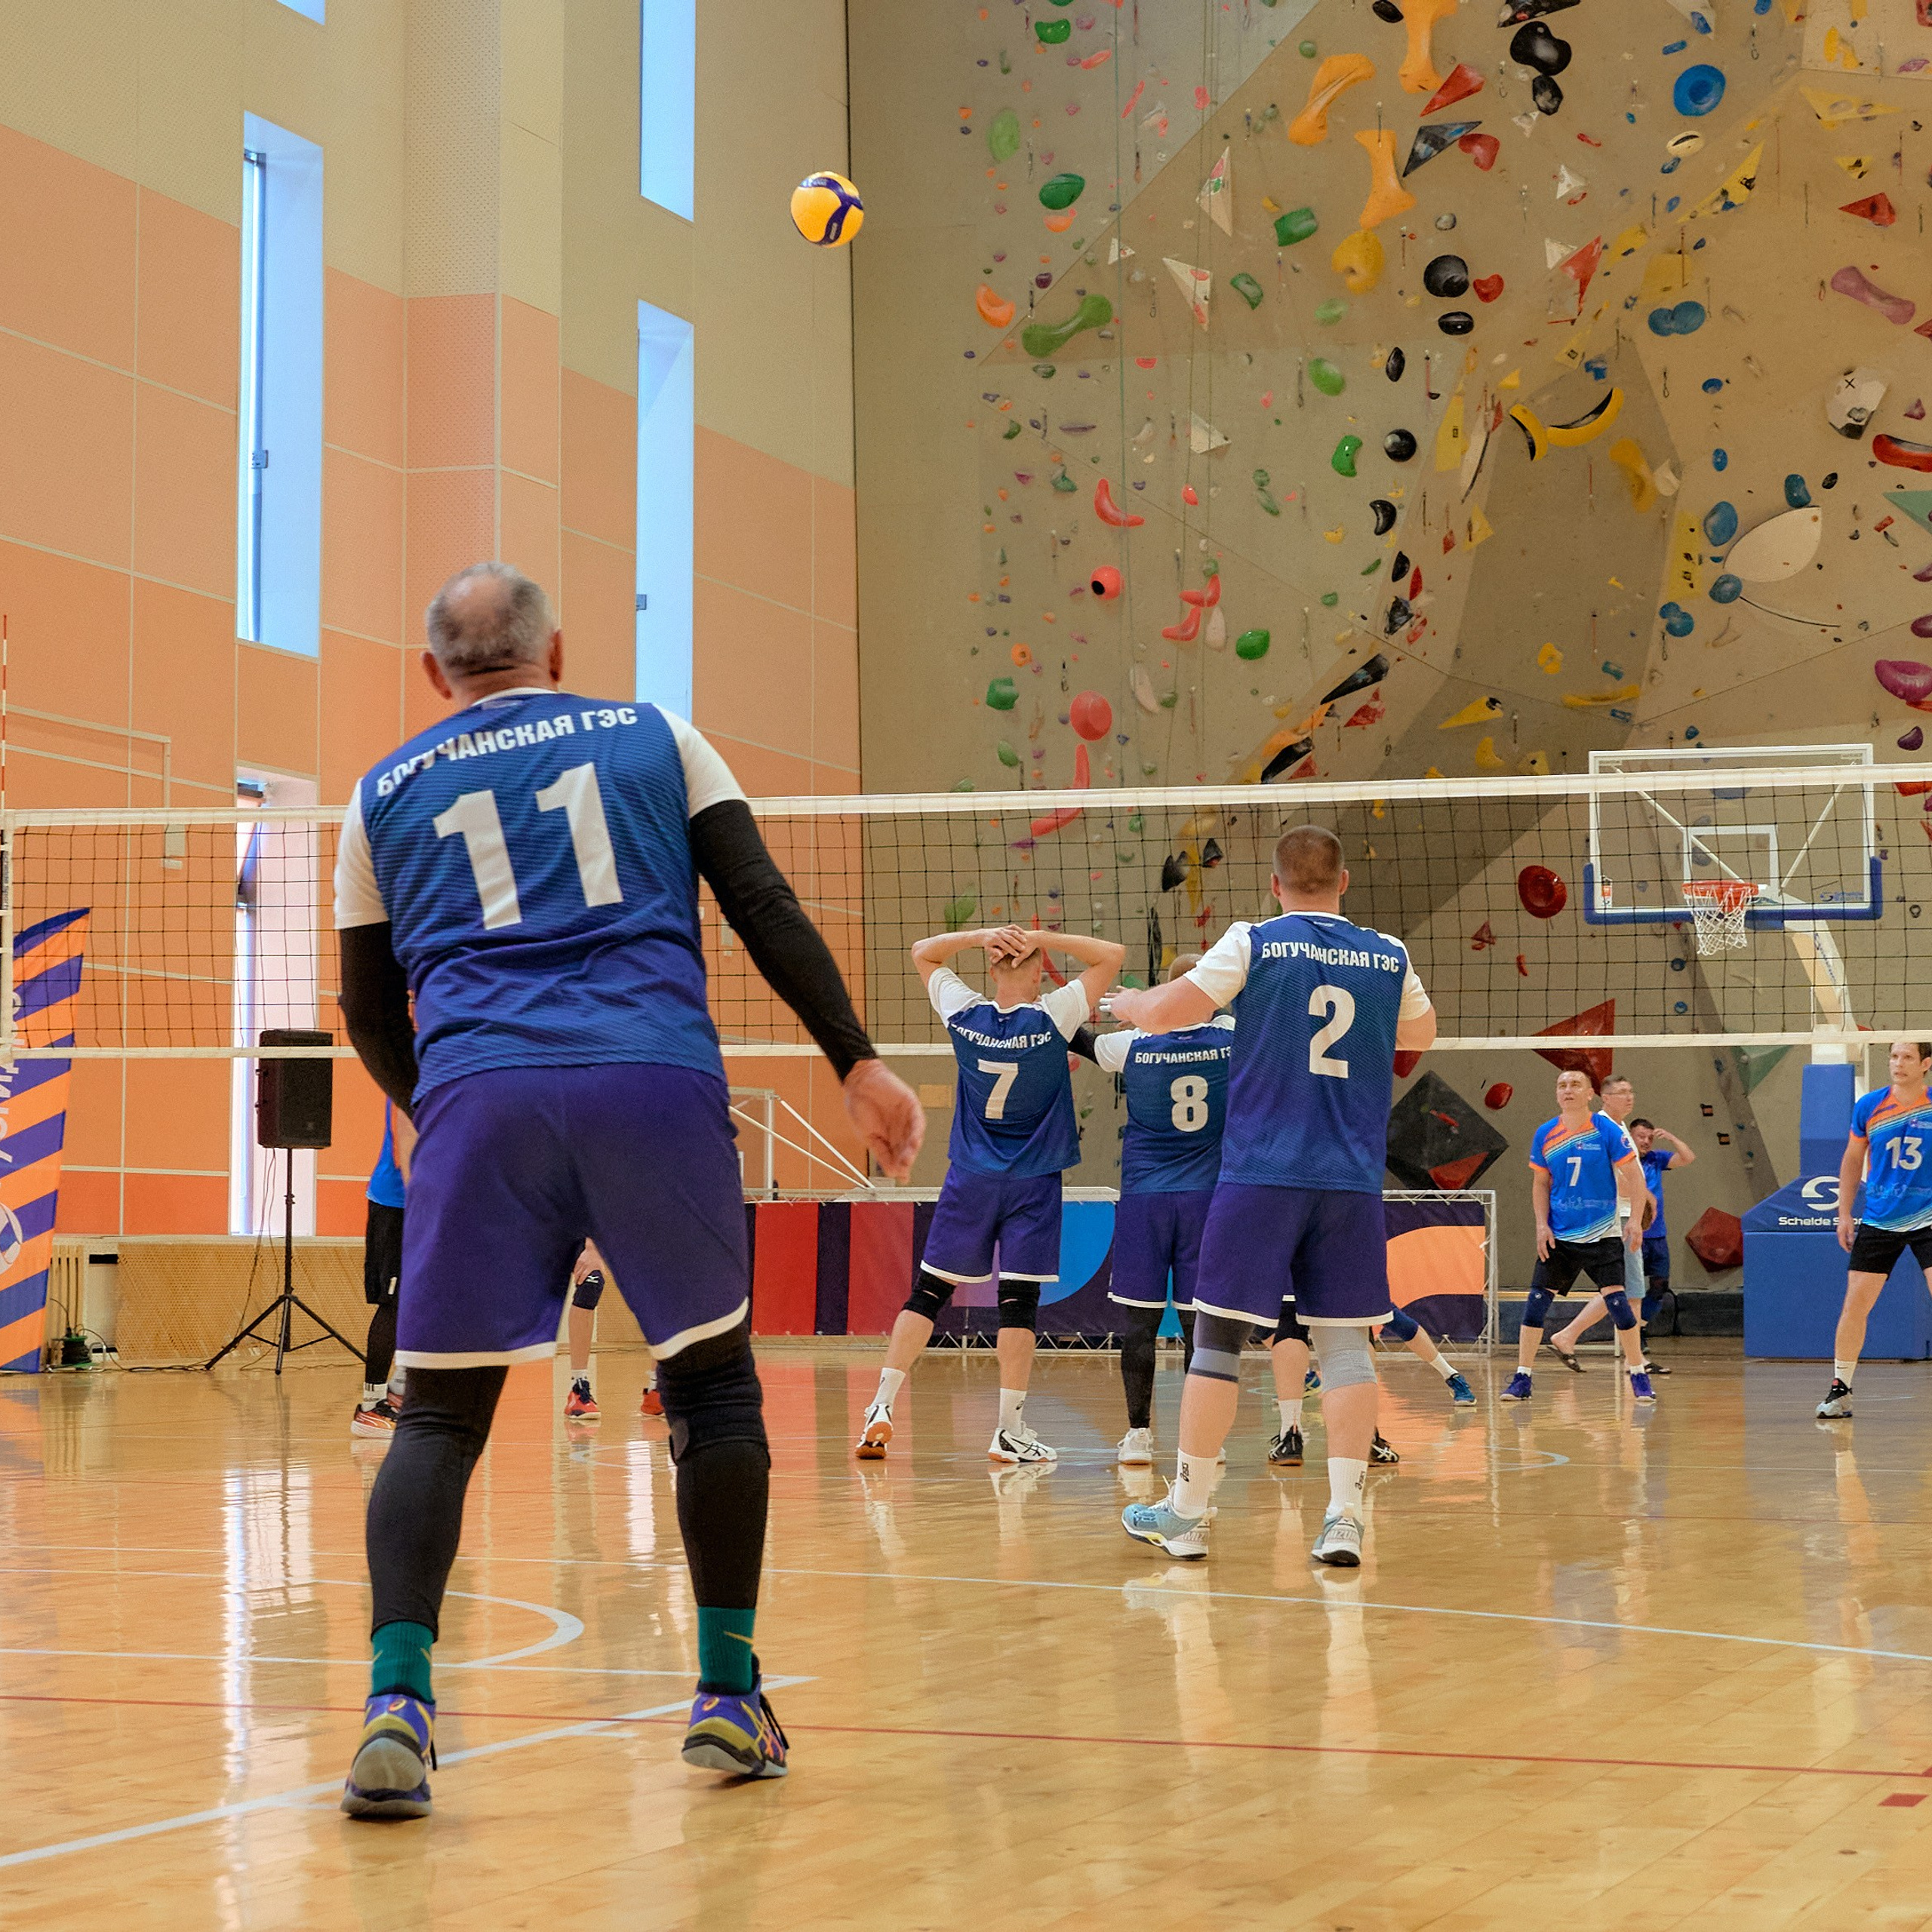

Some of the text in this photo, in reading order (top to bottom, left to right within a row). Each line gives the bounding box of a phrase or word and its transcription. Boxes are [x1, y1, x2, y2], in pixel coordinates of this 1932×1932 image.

[580, 707, 638, 731] ГЭС
[432, 761, 624, 931] 11
[1261, 941, 1400, 974] БОГУЧАНСКАЯ ГЭС
[951, 1023, 1053, 1049] ОГУЧАНСКАЯ ГЭС
[1308, 984, 1356, 1079] 2
[1134, 1046, 1232, 1065] БОГУЧАНСКАЯ ГЭ
[977, 1058, 1019, 1120] 7
[1170, 1075, 1209, 1133] 8
[1885, 1136, 1923, 1171] 13
[1567, 1156, 1583, 1187] 7
[1778, 1216, 1832, 1226] Schelde
